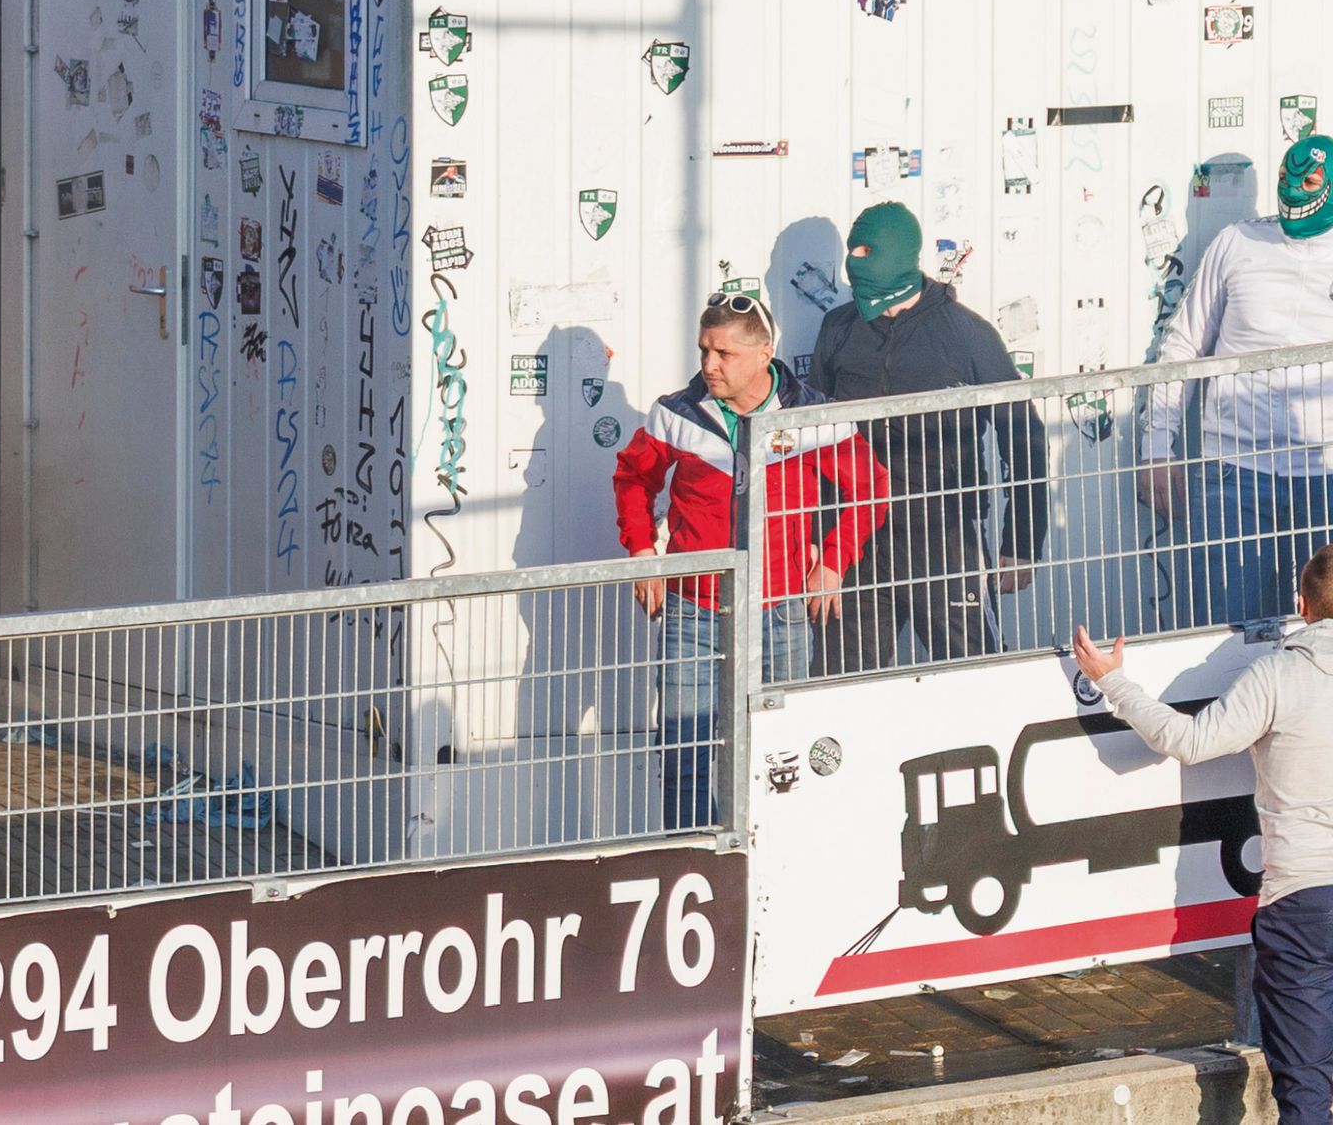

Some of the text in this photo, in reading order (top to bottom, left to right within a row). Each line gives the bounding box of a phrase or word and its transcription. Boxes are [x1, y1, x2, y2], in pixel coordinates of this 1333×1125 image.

[582, 192, 596, 201] TR
[513, 359, 546, 371] TORN
[512, 377, 545, 390] ADOS
[148, 892, 583, 1044] Oberrohr
[609, 873, 716, 994] 76
